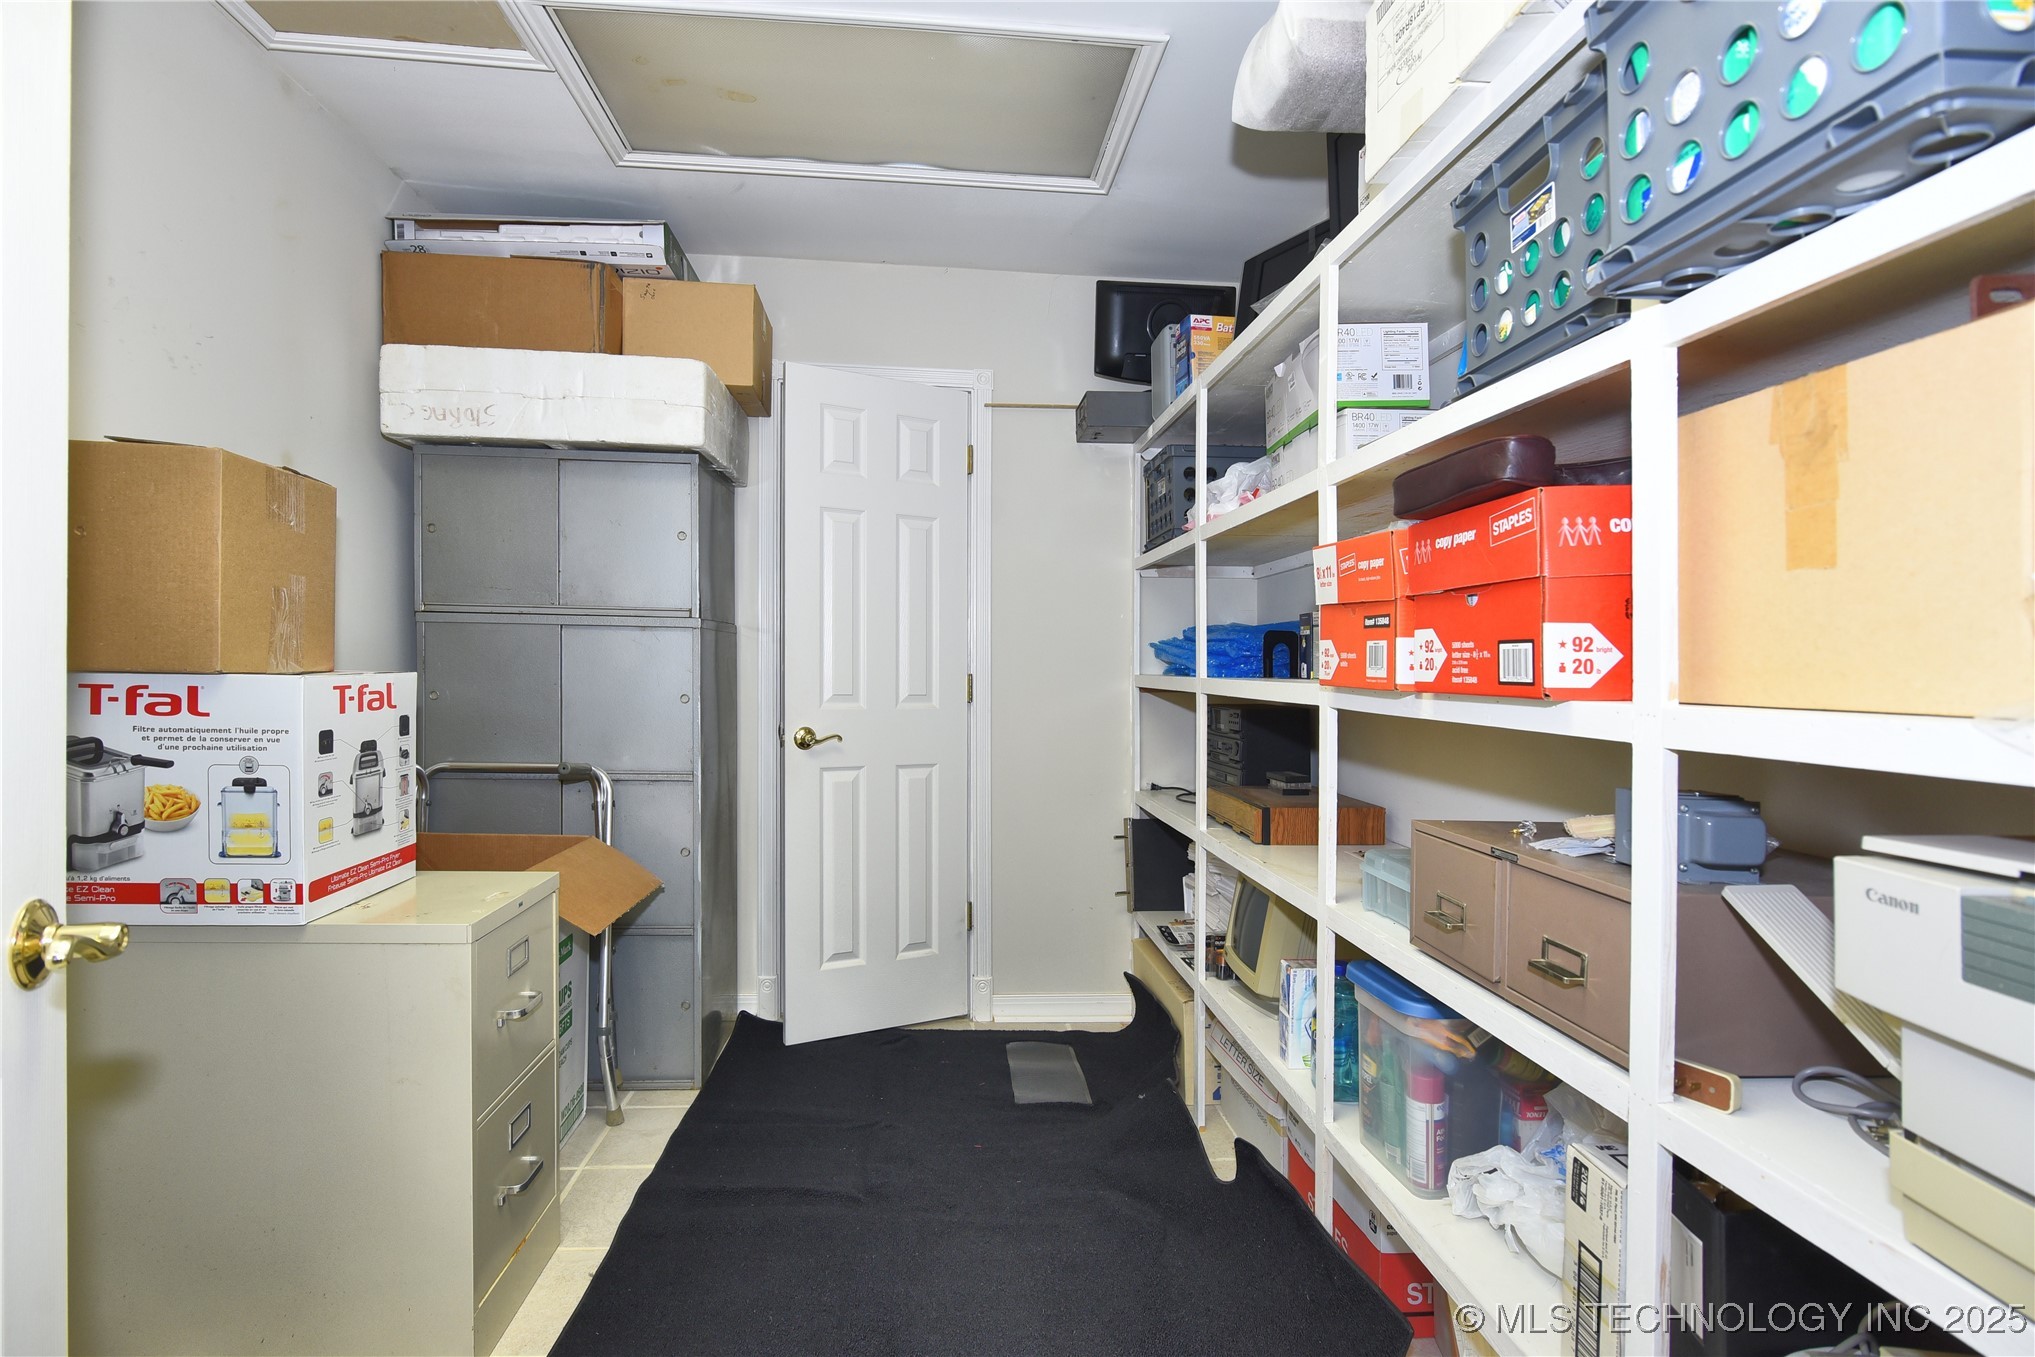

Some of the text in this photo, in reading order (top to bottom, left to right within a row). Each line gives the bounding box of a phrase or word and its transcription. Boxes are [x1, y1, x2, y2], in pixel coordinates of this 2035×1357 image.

[1216, 323, 1234, 333] Bat
[1351, 413, 1375, 421] BR40
[1492, 508, 1533, 536] STAPLES
[1609, 518, 1632, 533] co
[1435, 528, 1477, 551] copy paper
[1358, 557, 1385, 571] copy paper
[1424, 640, 1434, 652] 92
[1572, 637, 1594, 652] 92
[1425, 658, 1434, 670] 20
[1572, 658, 1594, 674] 20
[78, 684, 210, 717] T-fal
[333, 682, 397, 714] T-fal
[132, 725, 290, 737] Filtre automatiquement l'huile propre
[153, 736, 184, 744] permet
[157, 743, 267, 752] d'une prochaine utilisation
[89, 875, 97, 883] kg
[74, 894, 117, 902] Semi-Pro
[1865, 888, 1920, 915] Canon
[1219, 1035, 1247, 1069] LETTER
[1246, 1063, 1265, 1088] SIZE
